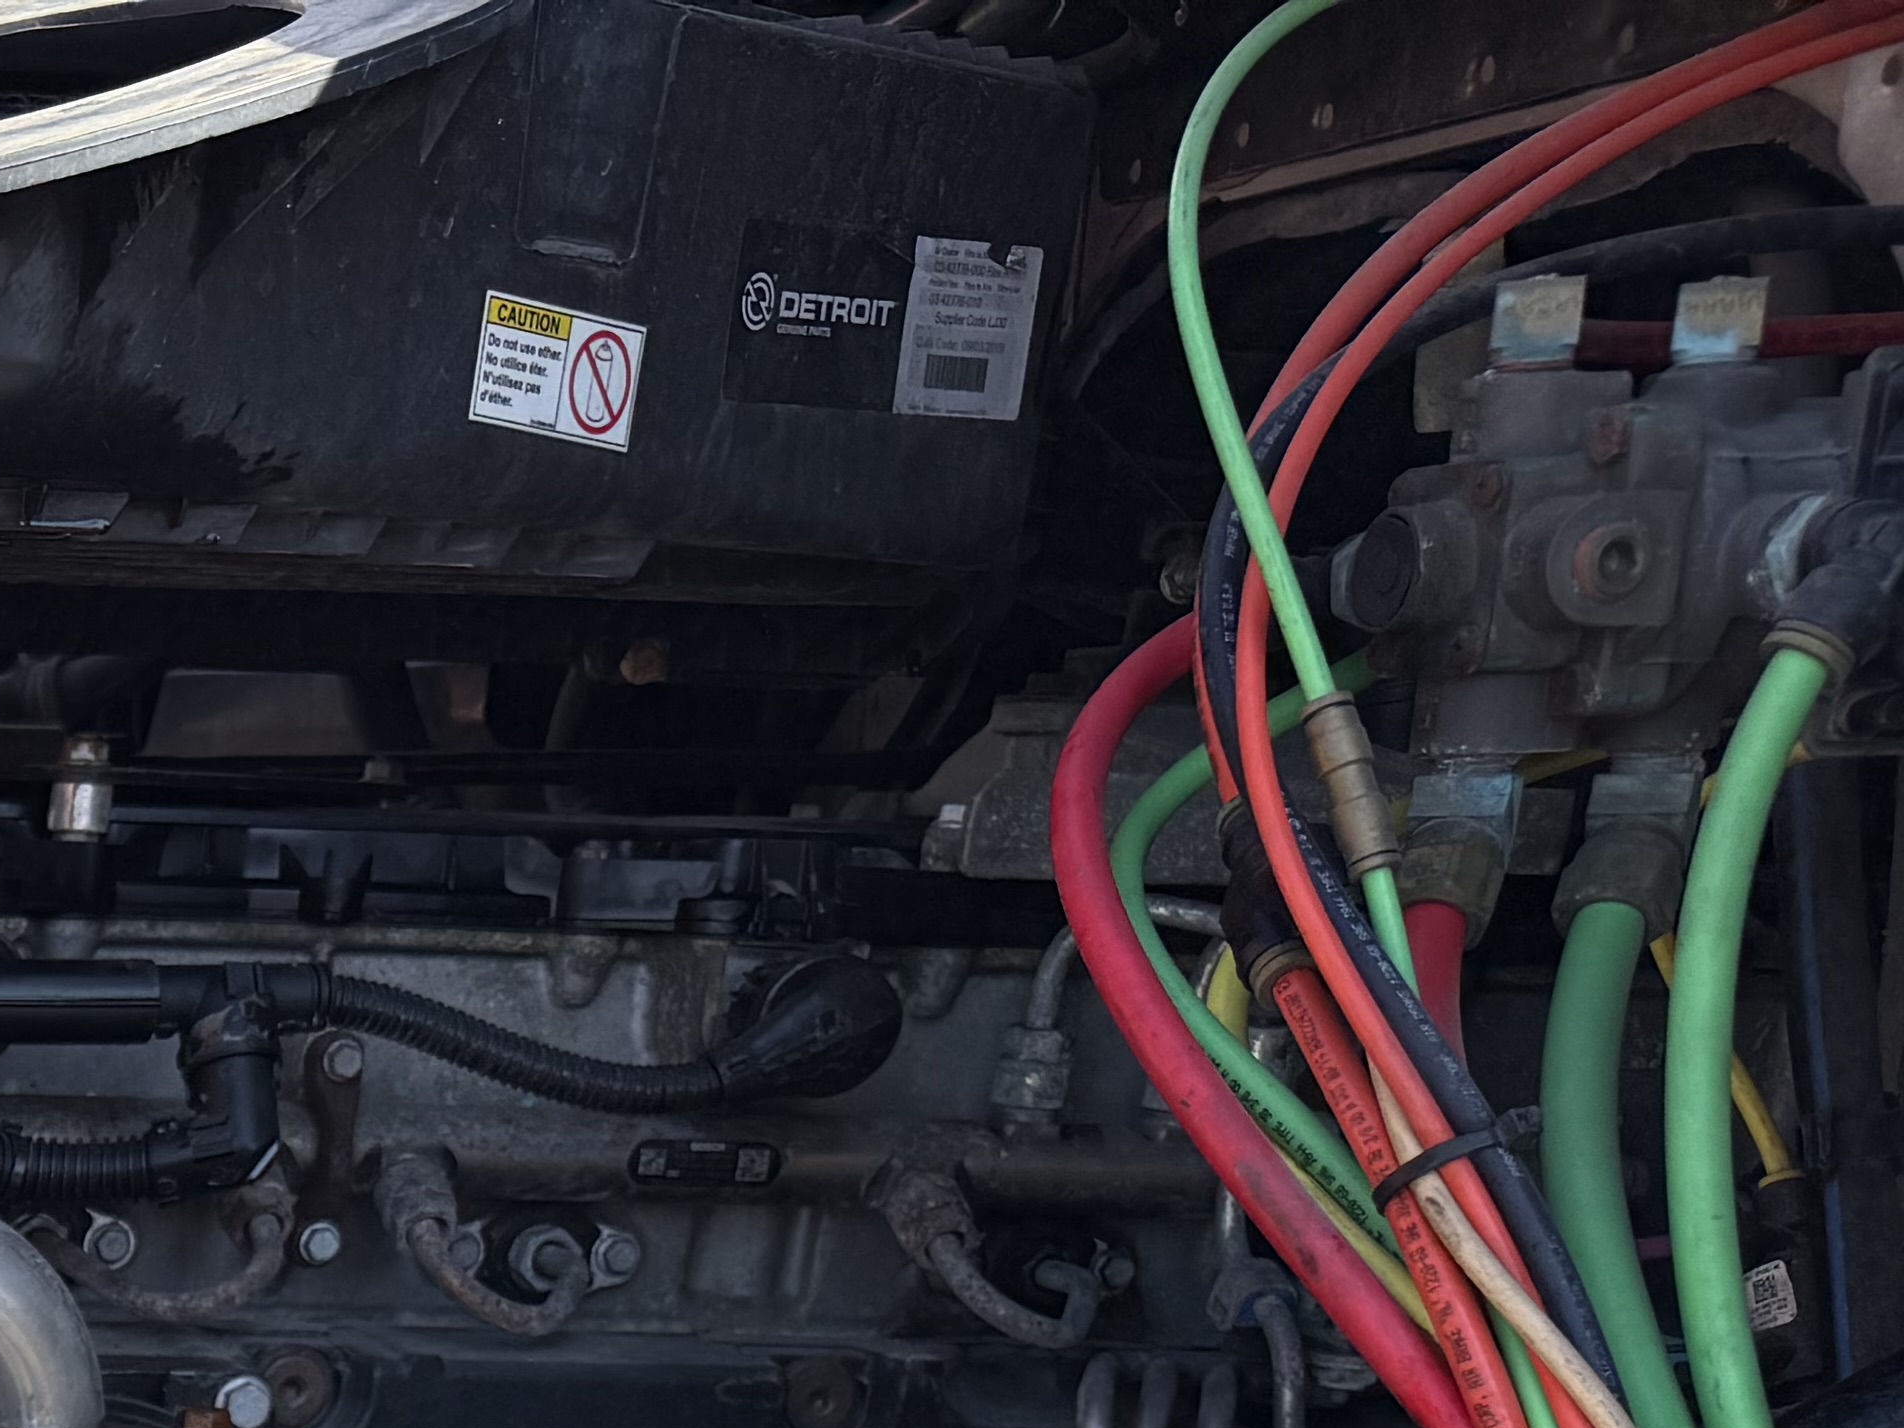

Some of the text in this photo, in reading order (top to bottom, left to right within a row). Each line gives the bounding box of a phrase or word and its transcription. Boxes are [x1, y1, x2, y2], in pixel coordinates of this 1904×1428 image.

[498, 303, 562, 335] CAUTION
[779, 291, 895, 326] DETROIT
[487, 333, 501, 347] Do
[503, 338, 519, 353] not
[520, 343, 536, 356] use
[485, 352, 499, 366] No
[525, 381, 542, 395] pas
